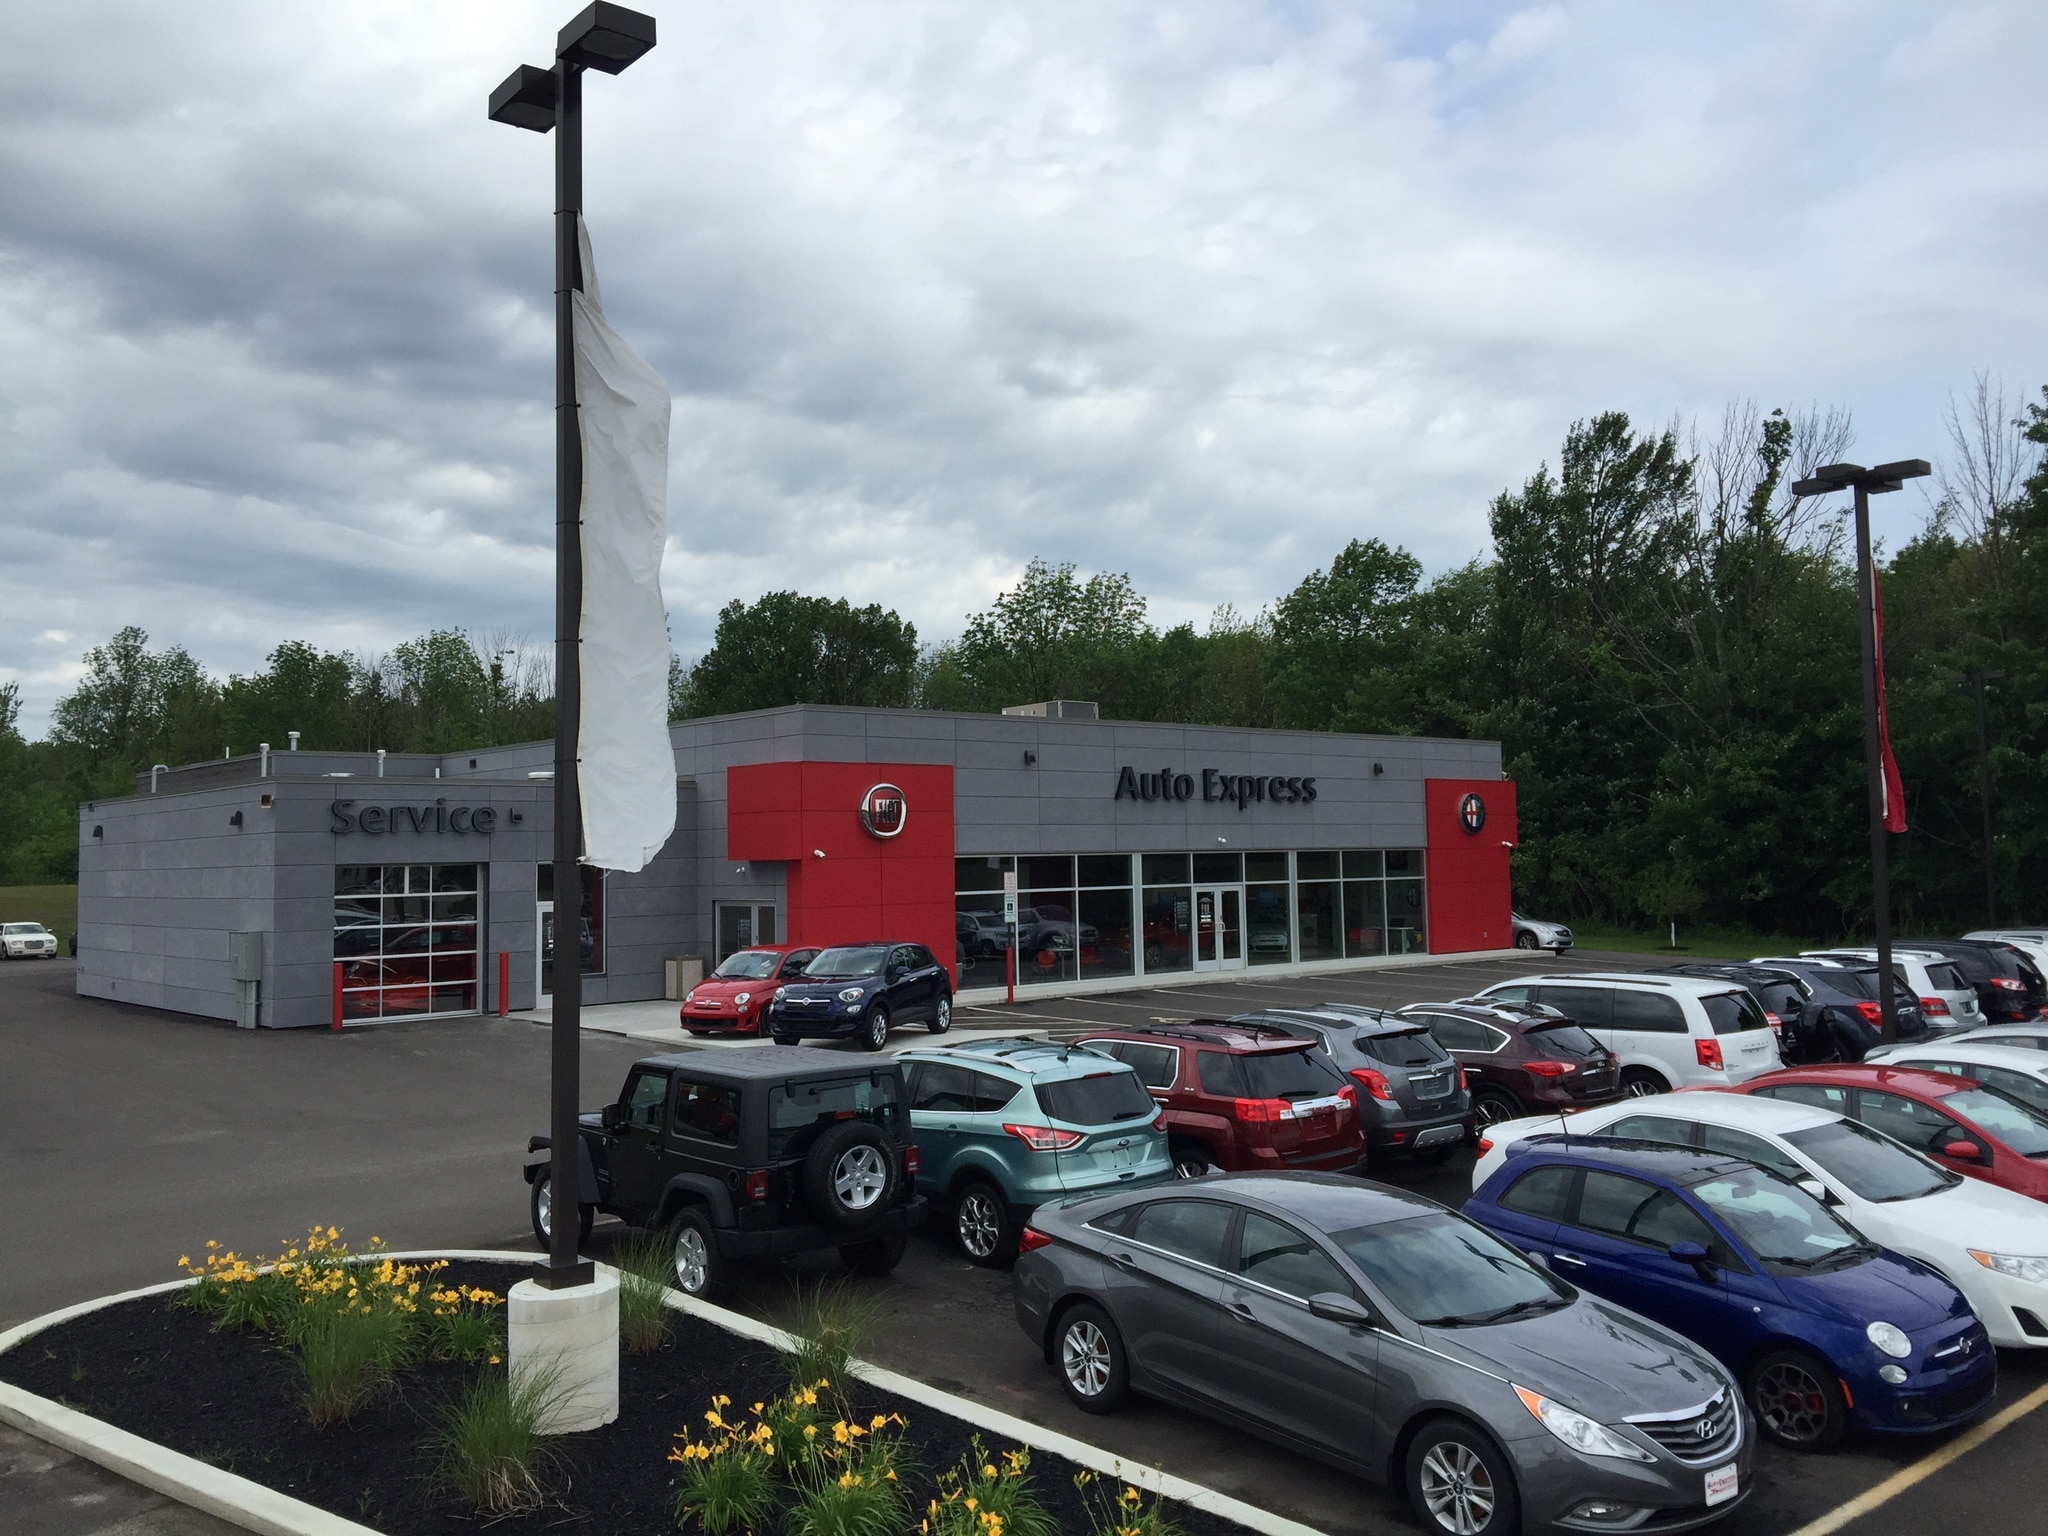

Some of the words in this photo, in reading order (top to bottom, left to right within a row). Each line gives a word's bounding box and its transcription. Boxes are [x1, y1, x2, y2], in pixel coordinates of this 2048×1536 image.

[1114, 766, 1195, 801] Auto
[1202, 768, 1317, 811] Express
[330, 797, 497, 834] Service
[875, 799, 900, 823] FIAT
